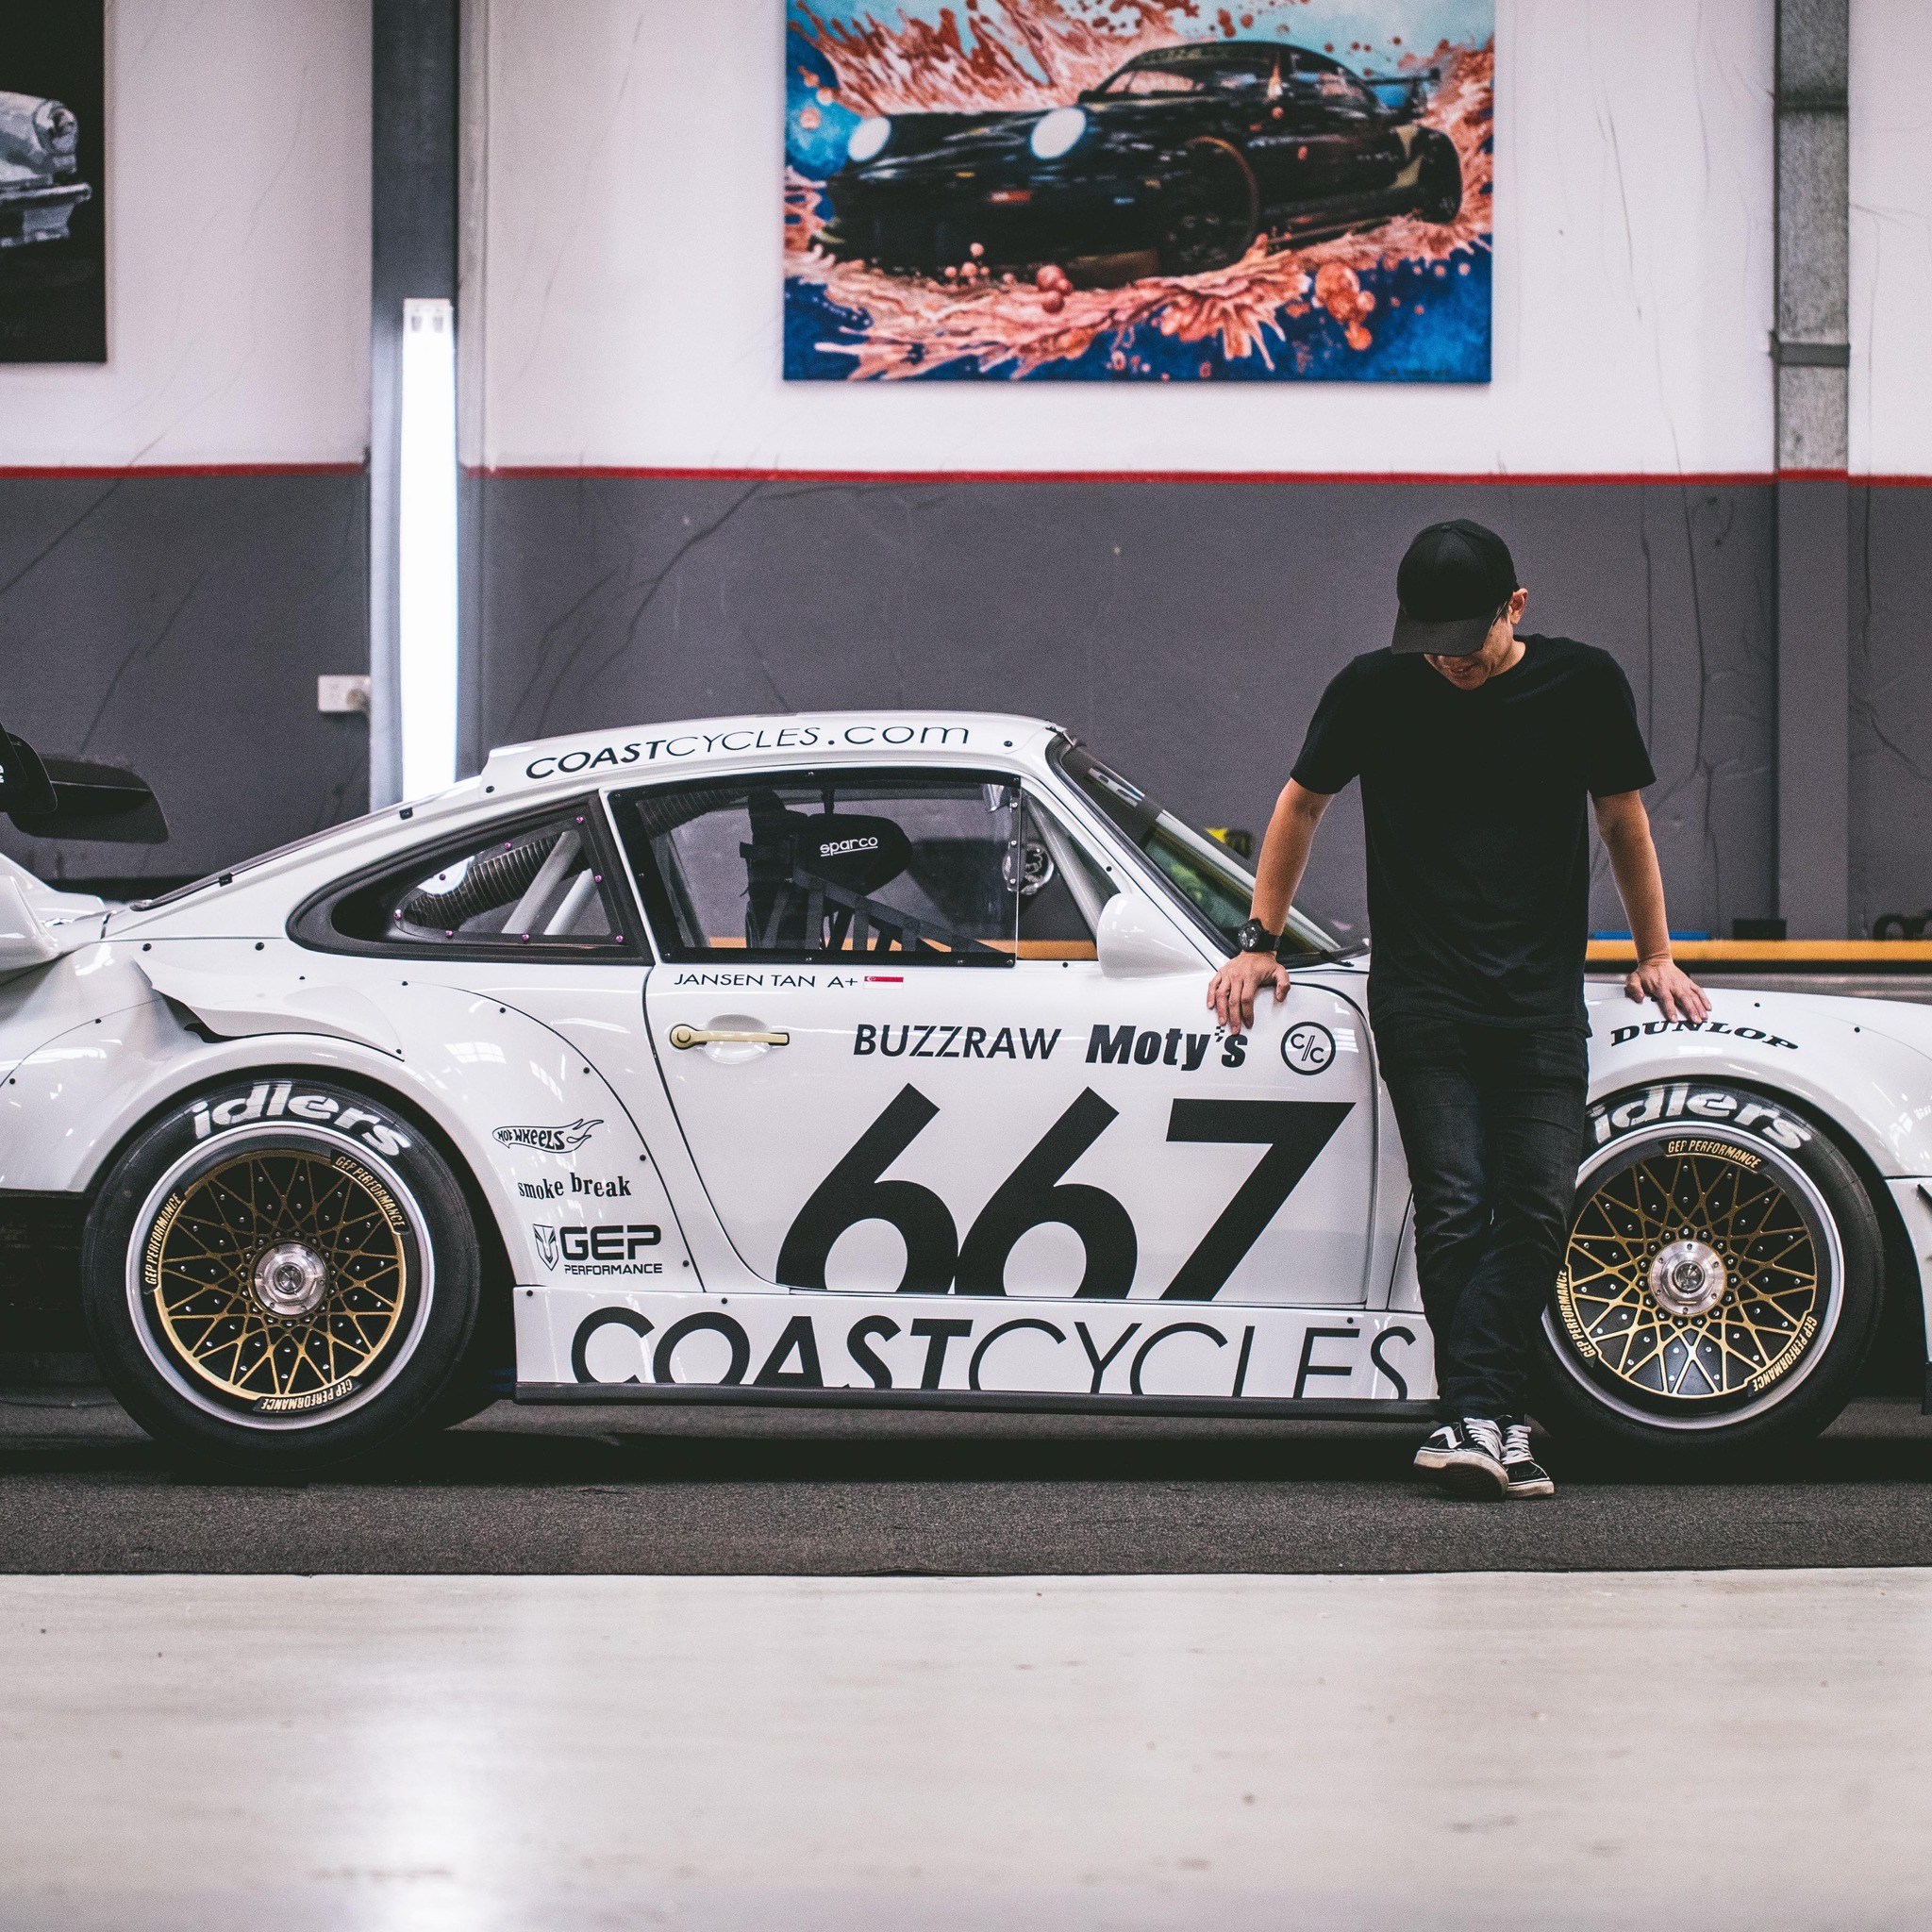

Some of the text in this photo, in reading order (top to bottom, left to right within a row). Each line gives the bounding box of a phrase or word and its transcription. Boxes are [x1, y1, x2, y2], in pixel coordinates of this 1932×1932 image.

[526, 725, 969, 779] COASTCYCLES.com
[820, 837, 878, 857] sparco
[674, 974, 858, 989] JANSEN TAN A+
[853, 1024, 1061, 1059] BUZZRAW
[1085, 1024, 1248, 1072] Moty's
[1611, 1021, 1799, 1050] DUNLOP
[192, 1082, 410, 1157] idlers
[1590, 1083, 1811, 1150] idlers
[1668, 1140, 1762, 1169] GEP PERFORMANCE
[335, 1156, 406, 1227] GEP PERFORMANCE
[518, 1172, 631, 1199] smoke break
[775, 1082, 1357, 1301] 667
[144, 1192, 182, 1285] GEP PERFORMANCE
[559, 1224, 661, 1260] GEP
[564, 1263, 662, 1274] PERFORMANCE
[1557, 1270, 1596, 1358] GEP PERFORMANCE
[1754, 1316, 1818, 1392] GEP PERFORMANCE
[260, 1379, 353, 1411] GEP PERFORMANCE
